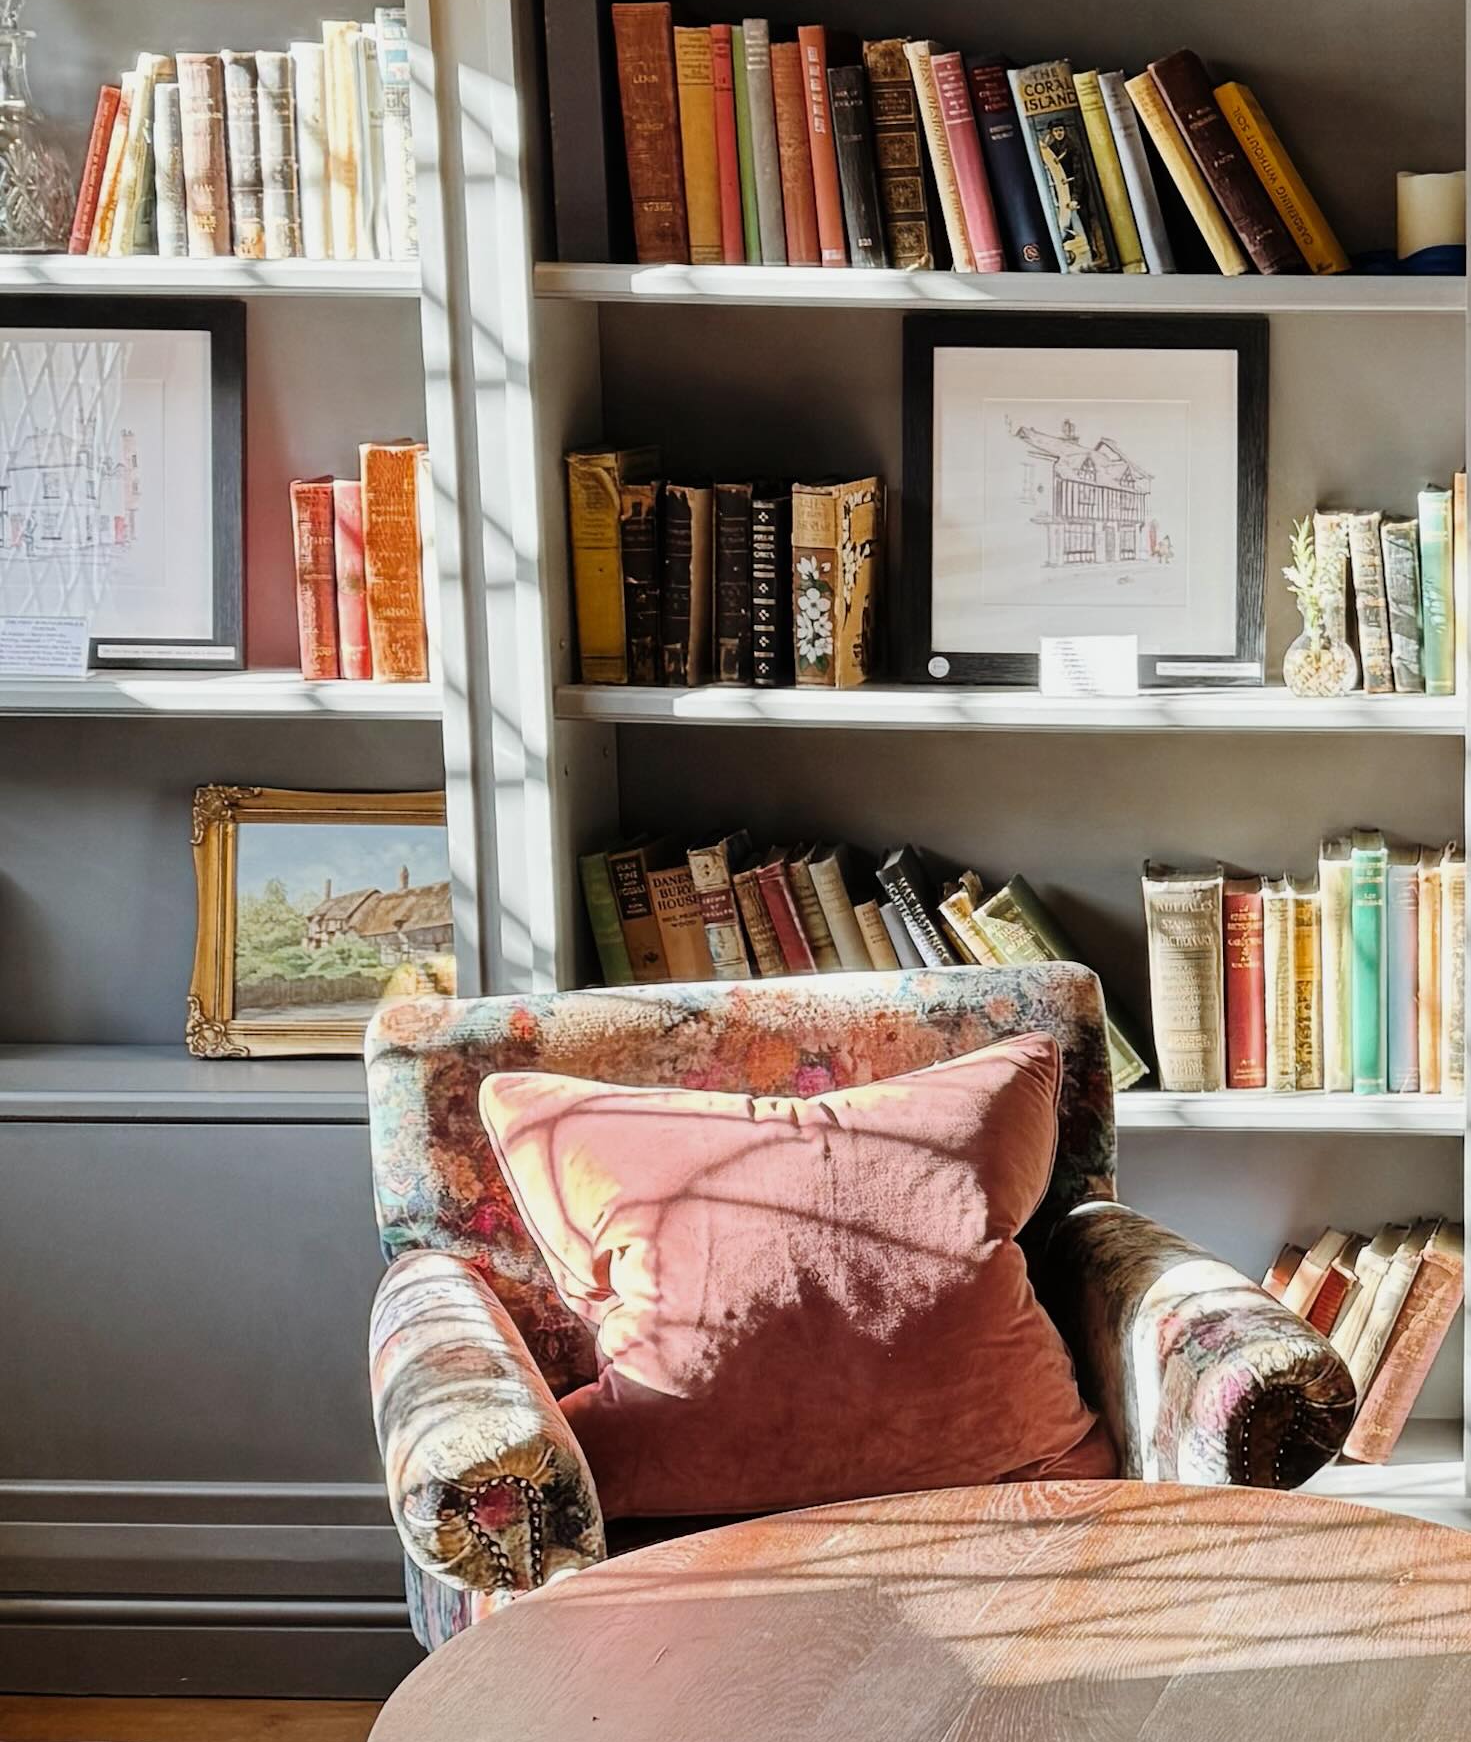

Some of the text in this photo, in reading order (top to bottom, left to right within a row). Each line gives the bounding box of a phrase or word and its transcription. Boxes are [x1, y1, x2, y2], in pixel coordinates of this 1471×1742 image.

[1031, 69, 1058, 80] THE
[1024, 81, 1073, 97] CORAL
[1023, 91, 1077, 112] ISLAND
[1232, 106, 1315, 246] GARDENING WITHOUT SOIL
[659, 883, 691, 899] BURY
[897, 877, 916, 903] MAX
[657, 892, 699, 911] HOUSE
[911, 903, 949, 961] HASTINGS
